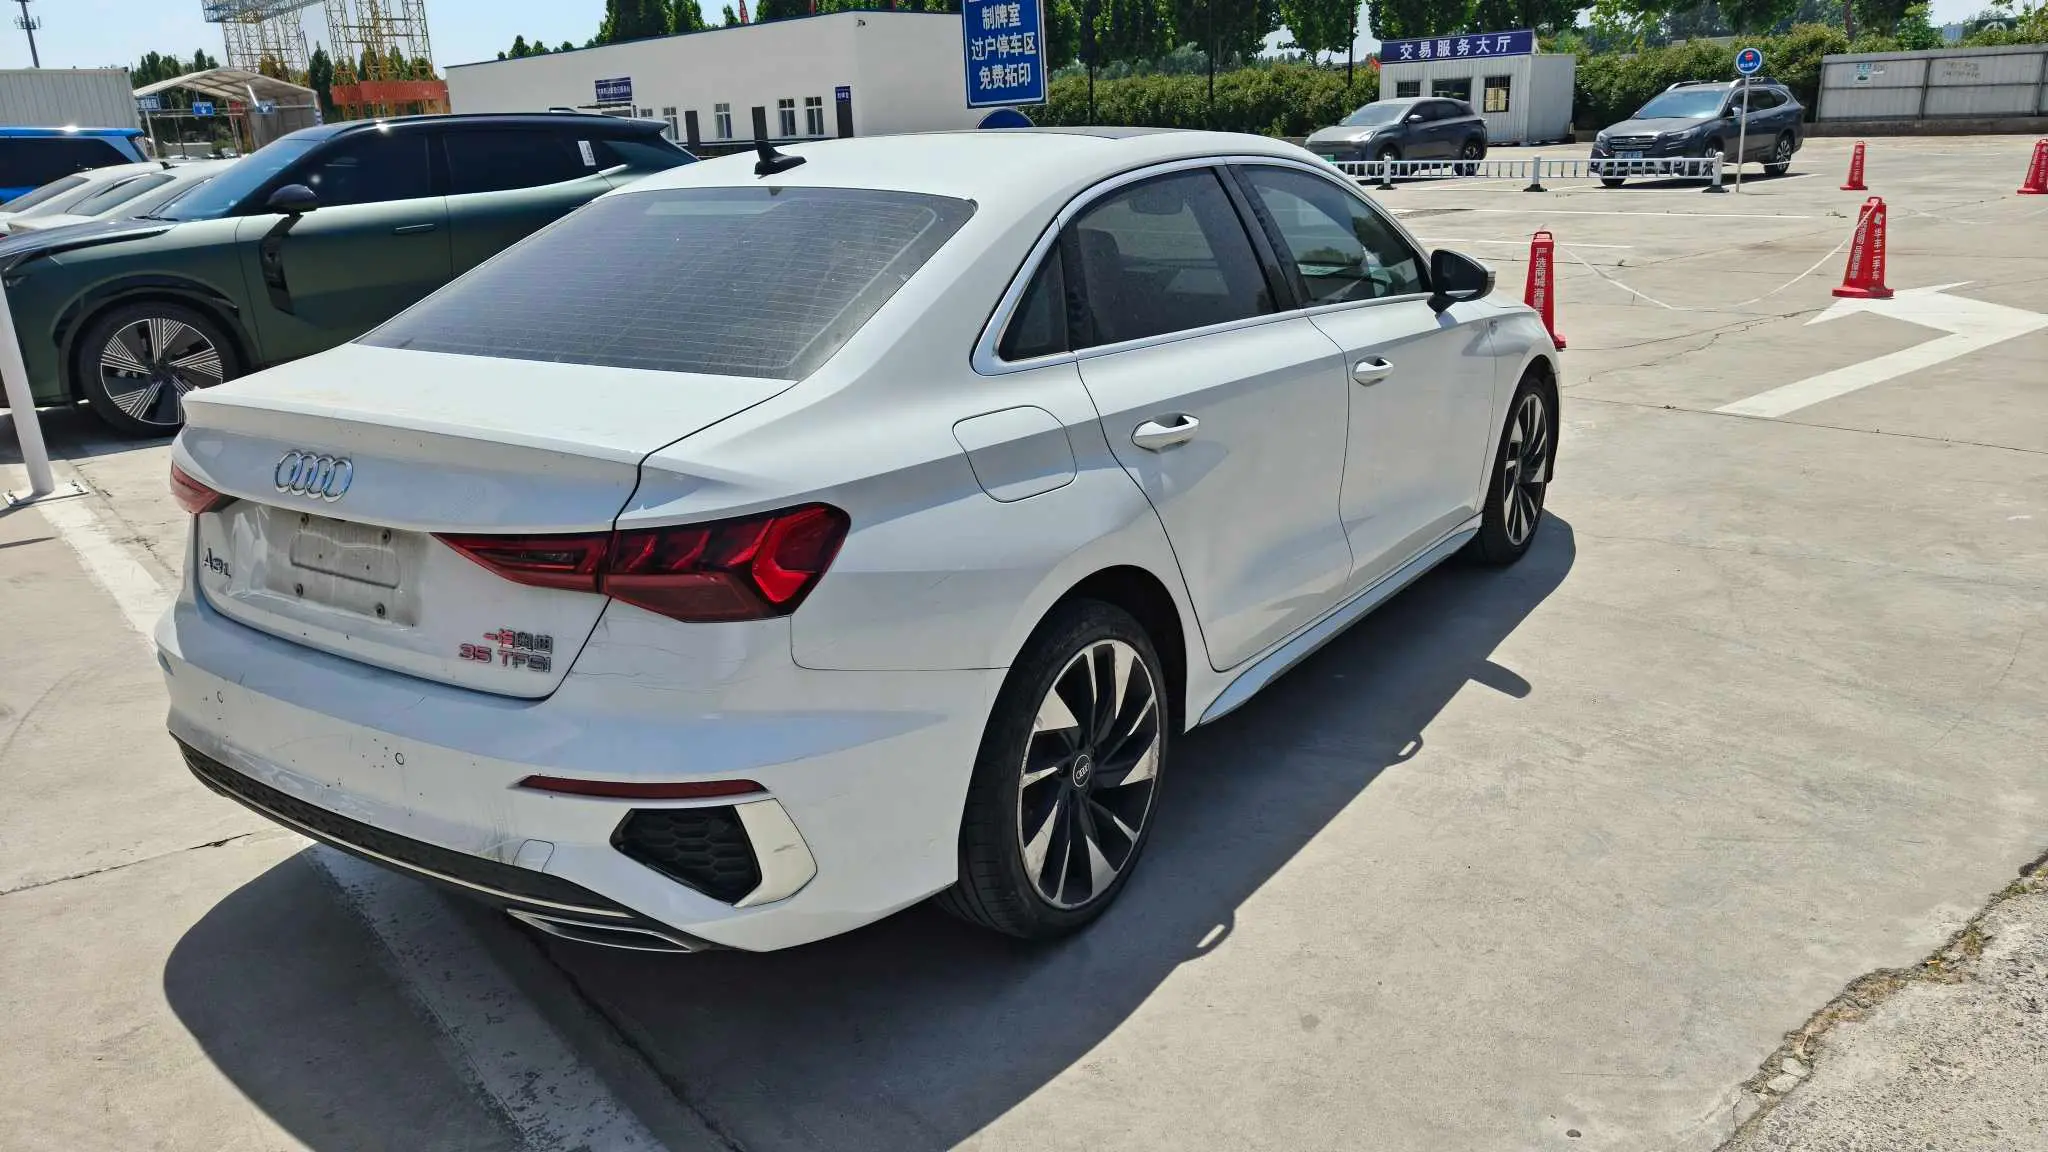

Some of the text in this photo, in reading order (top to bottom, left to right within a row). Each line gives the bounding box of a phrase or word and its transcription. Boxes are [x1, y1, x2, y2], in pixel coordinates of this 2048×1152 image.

[981, 3, 1021, 30] 制牌室
[971, 31, 1036, 60] 过户停车区
[1400, 35, 1511, 60] 交易服务大厅
[979, 62, 1031, 90] 免费拓印
[203, 547, 232, 579] A3L
[459, 643, 552, 673] 35 TFSI
